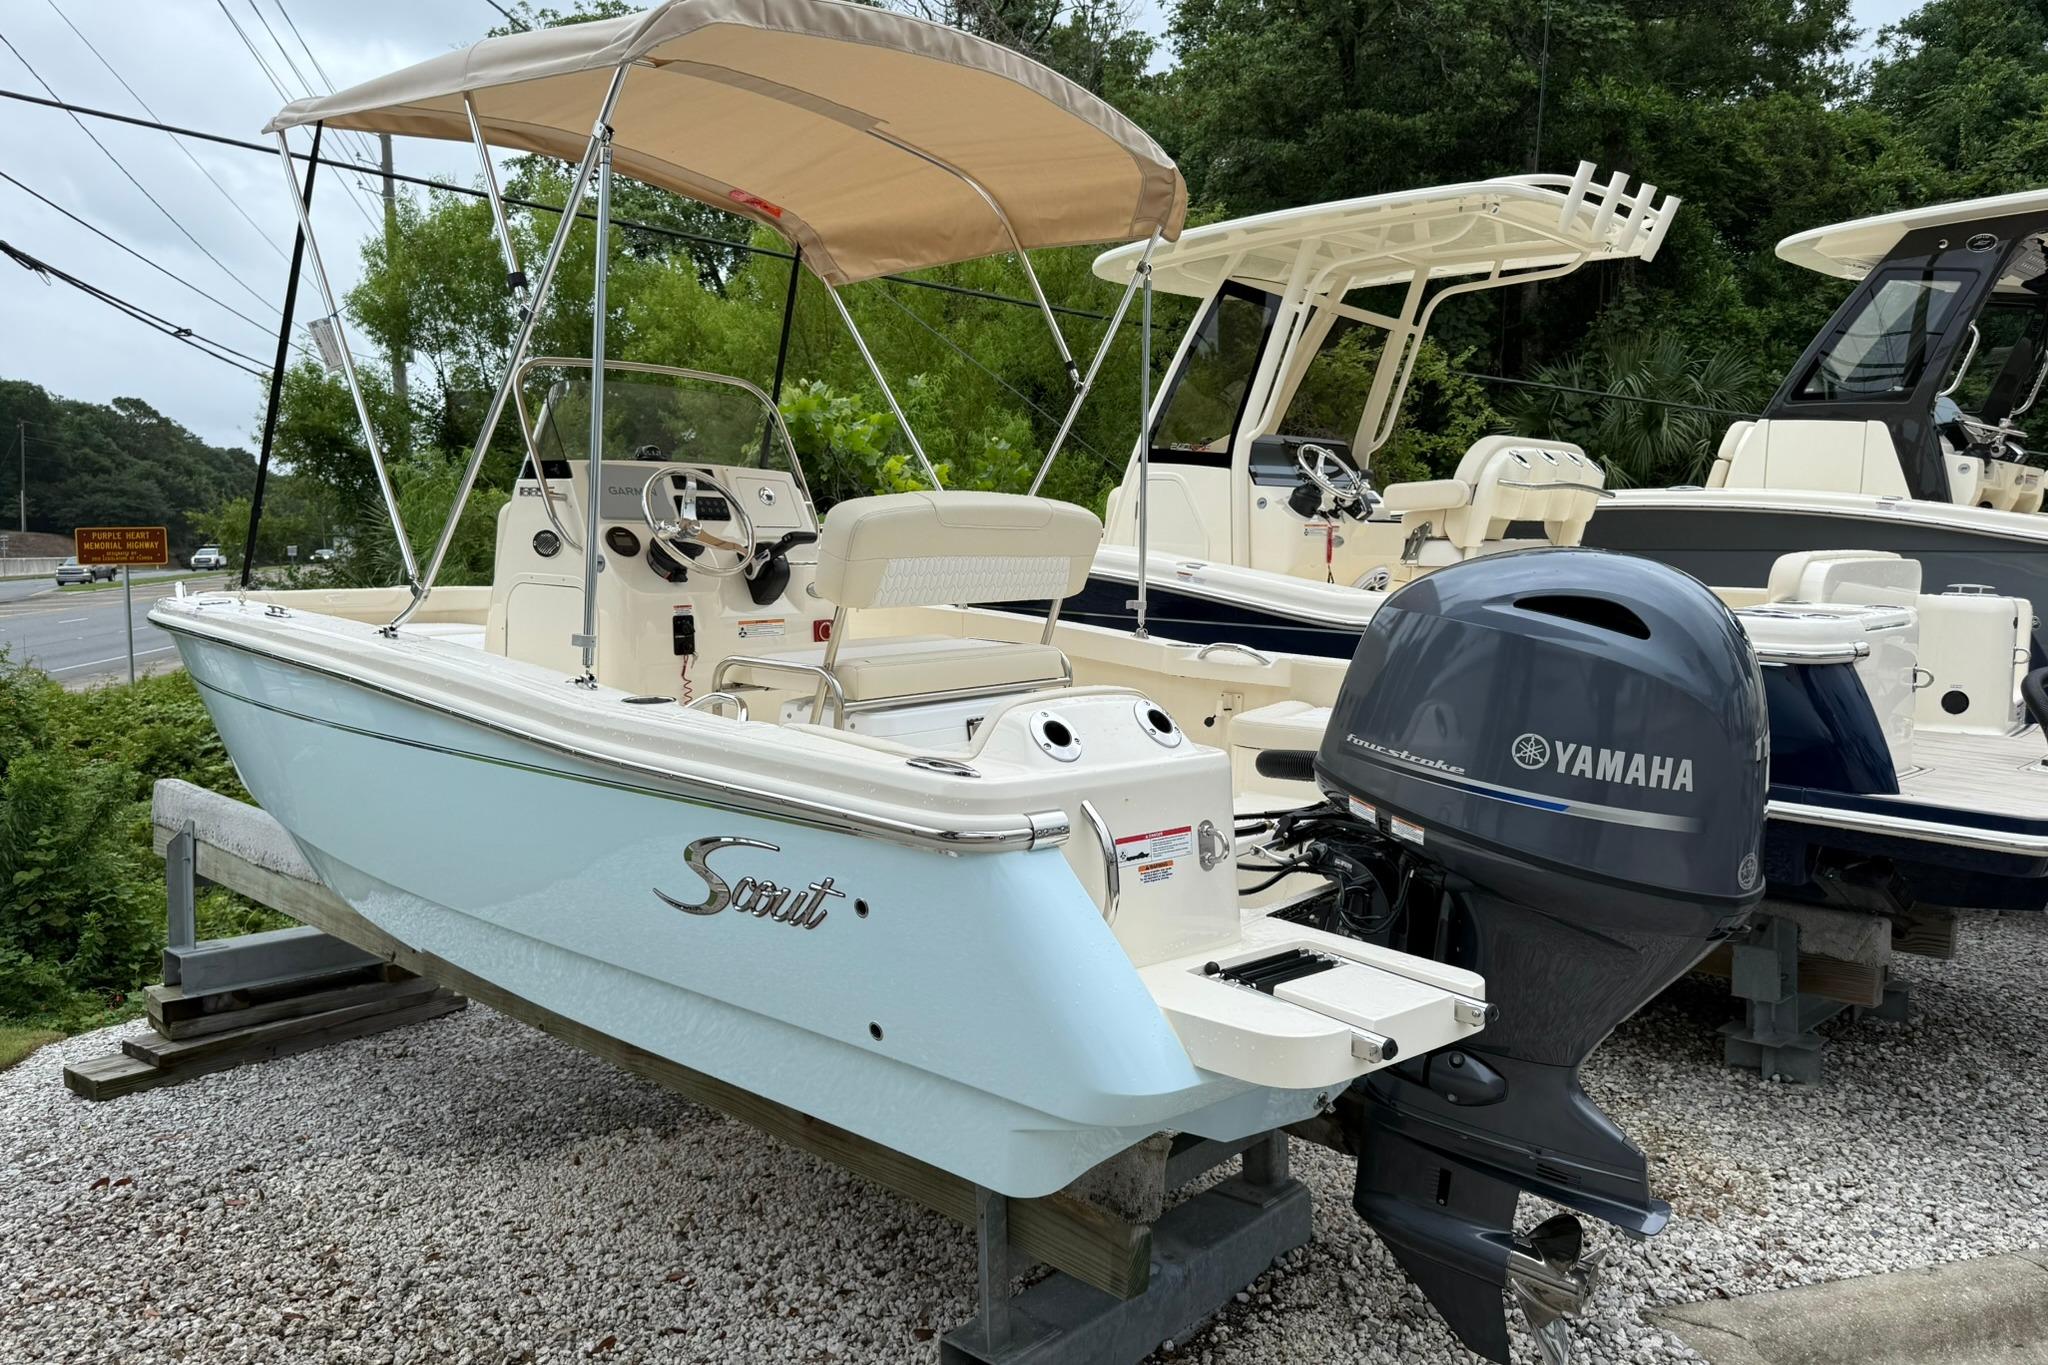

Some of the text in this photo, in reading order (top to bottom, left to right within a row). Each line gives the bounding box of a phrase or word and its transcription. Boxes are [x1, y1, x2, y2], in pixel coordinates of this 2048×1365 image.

[608, 485, 658, 497] GARMN
[91, 531, 150, 540] PURPLE HEART
[83, 541, 160, 550] MEMORIAL HIGHWAY
[1554, 740, 1695, 793] YAMAHA
[652, 835, 847, 930] Scout
